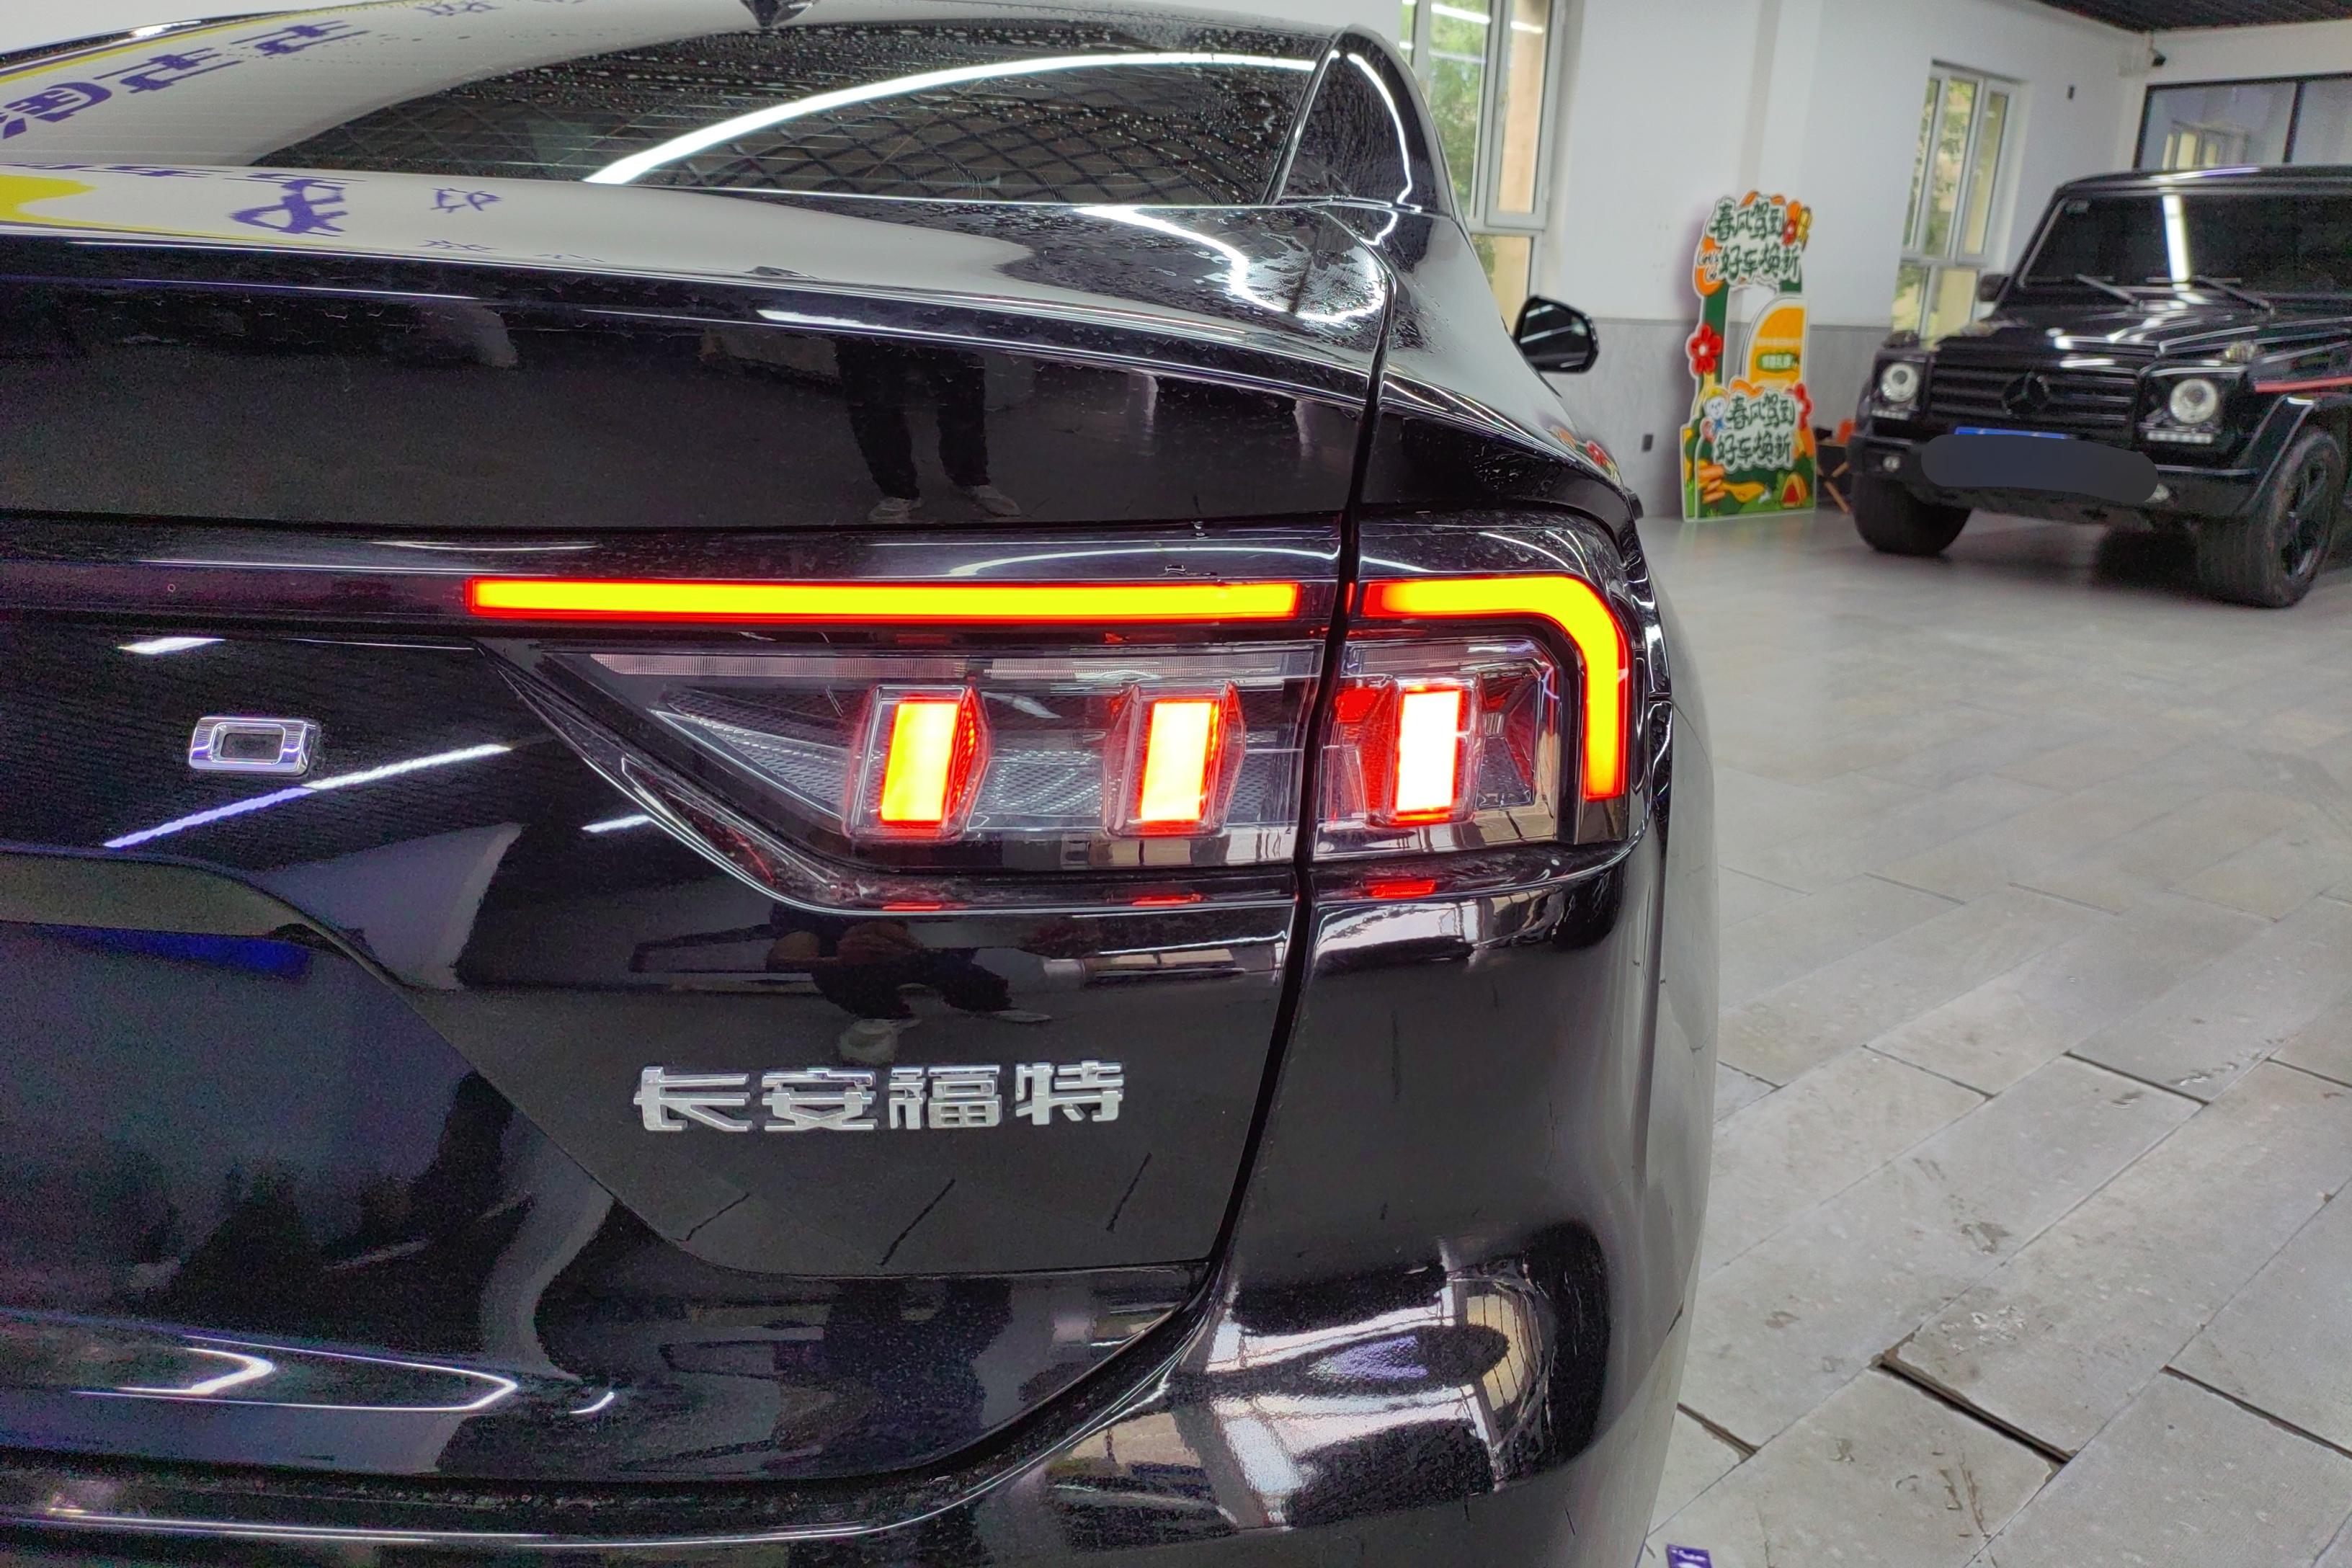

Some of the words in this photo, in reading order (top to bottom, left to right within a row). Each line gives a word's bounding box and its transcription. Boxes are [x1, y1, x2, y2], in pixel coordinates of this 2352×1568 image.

[1709, 199, 1783, 241] 春风驾到
[1726, 393, 1796, 429] 春风驾到
[633, 1060, 1125, 1131] 长安福特
